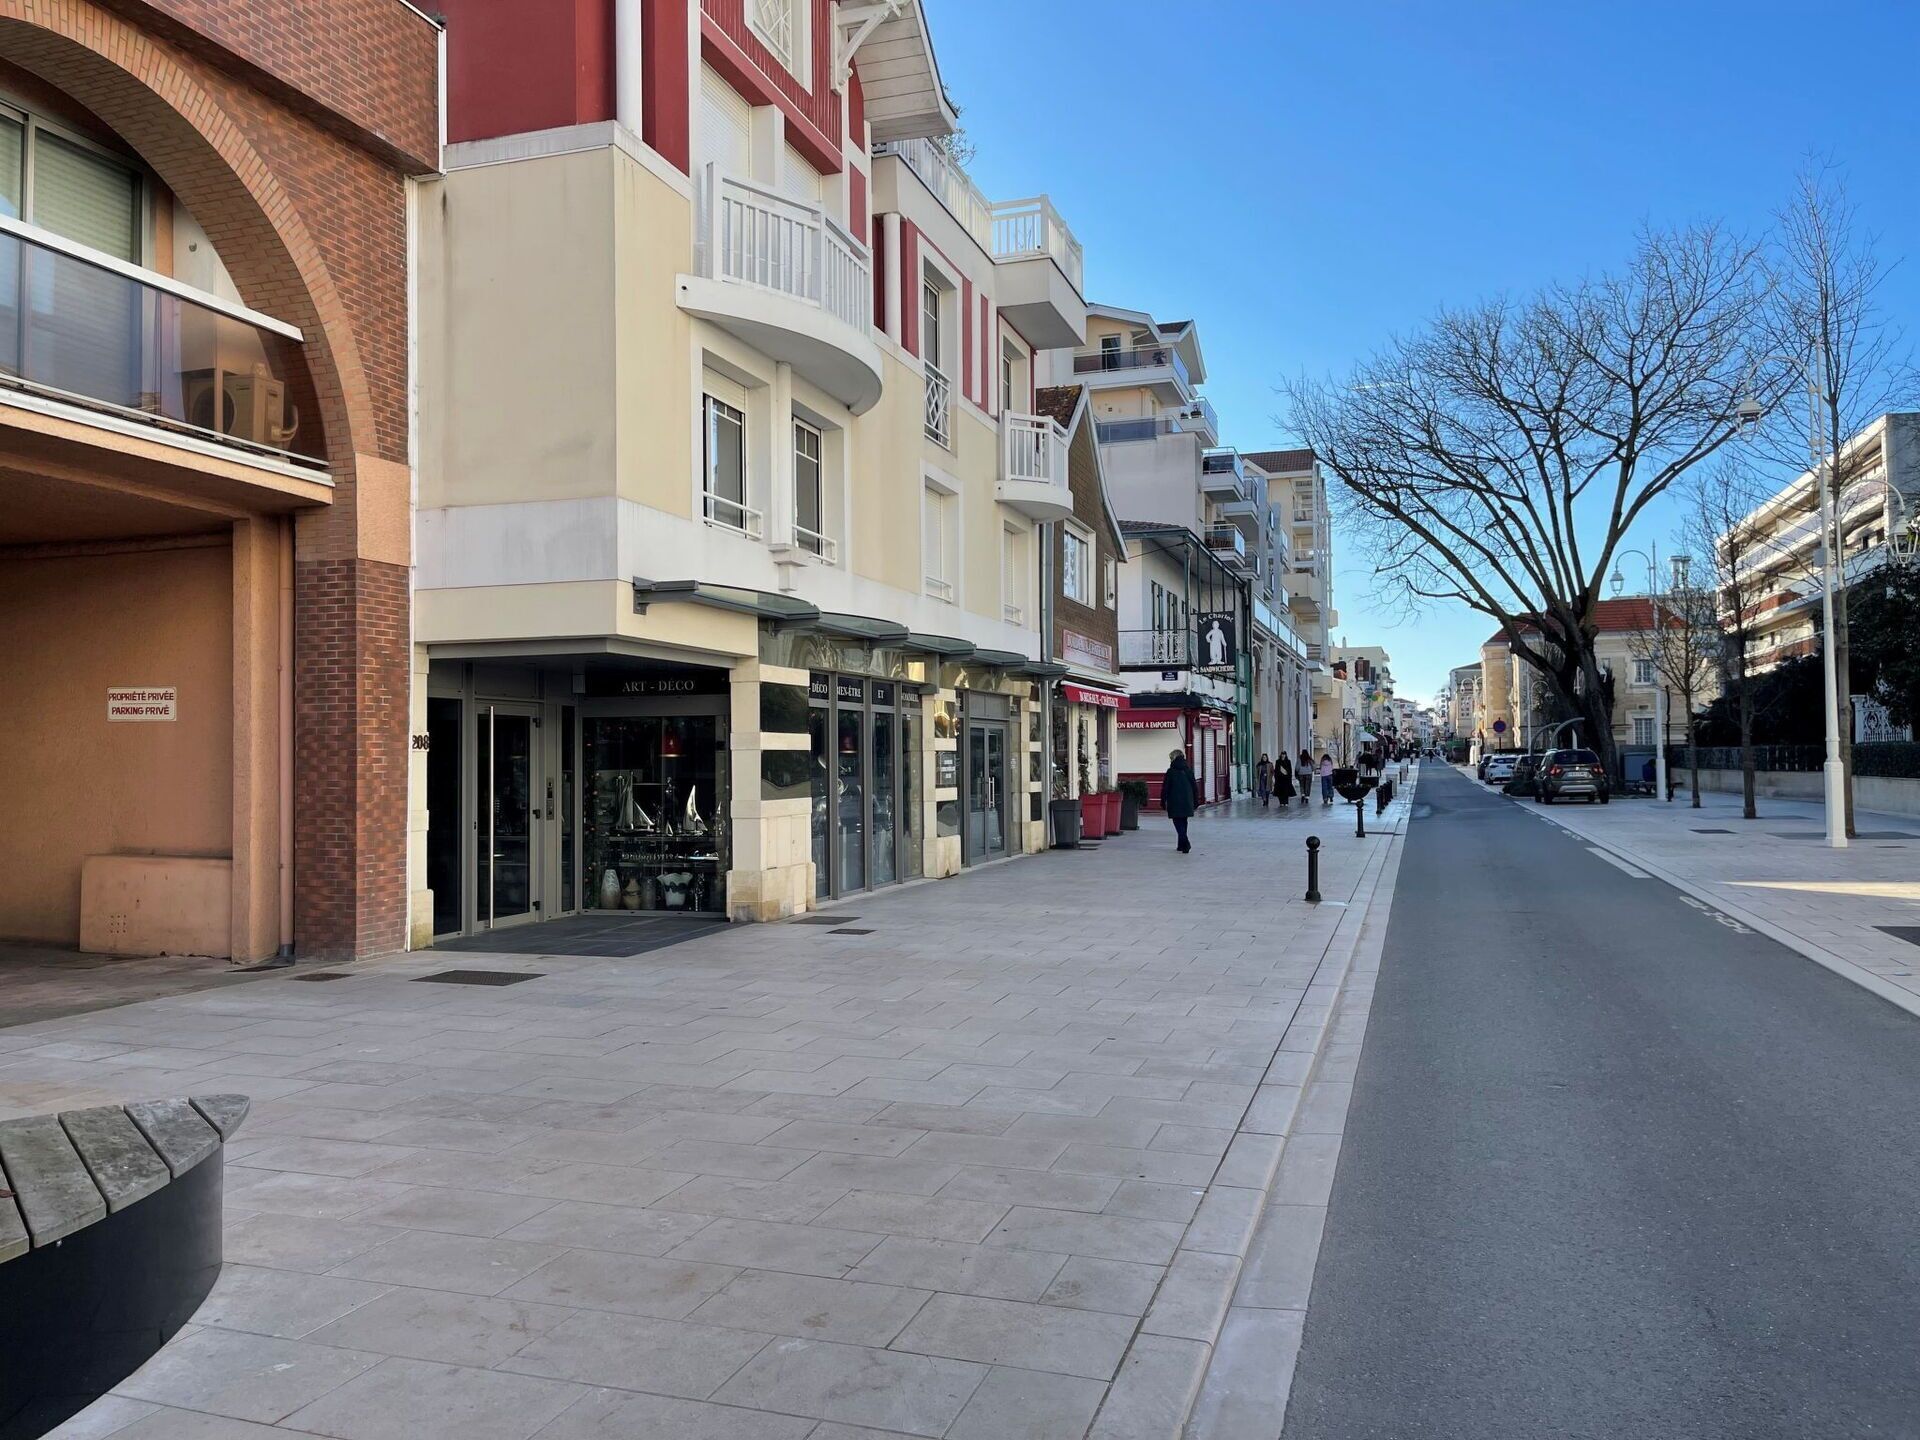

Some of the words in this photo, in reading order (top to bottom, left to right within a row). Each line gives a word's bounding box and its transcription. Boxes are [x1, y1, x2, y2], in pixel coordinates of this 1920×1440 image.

[622, 681, 646, 692] ART
[658, 678, 695, 691] DÉCO
[811, 681, 828, 694] DÉCO
[836, 685, 862, 697] IEN-ÊTRE
[877, 689, 885, 699] ET
[108, 691, 147, 701] PROPRIÉTÉ
[147, 690, 174, 701] PRIVÉE
[111, 706, 144, 715] PARKING
[145, 704, 170, 715] PRIVÉ
[1116, 721, 1126, 729] ON
[1126, 721, 1145, 729] RAPIDE
[1150, 721, 1176, 729] EMPORTER
[412, 734, 429, 750] 208
